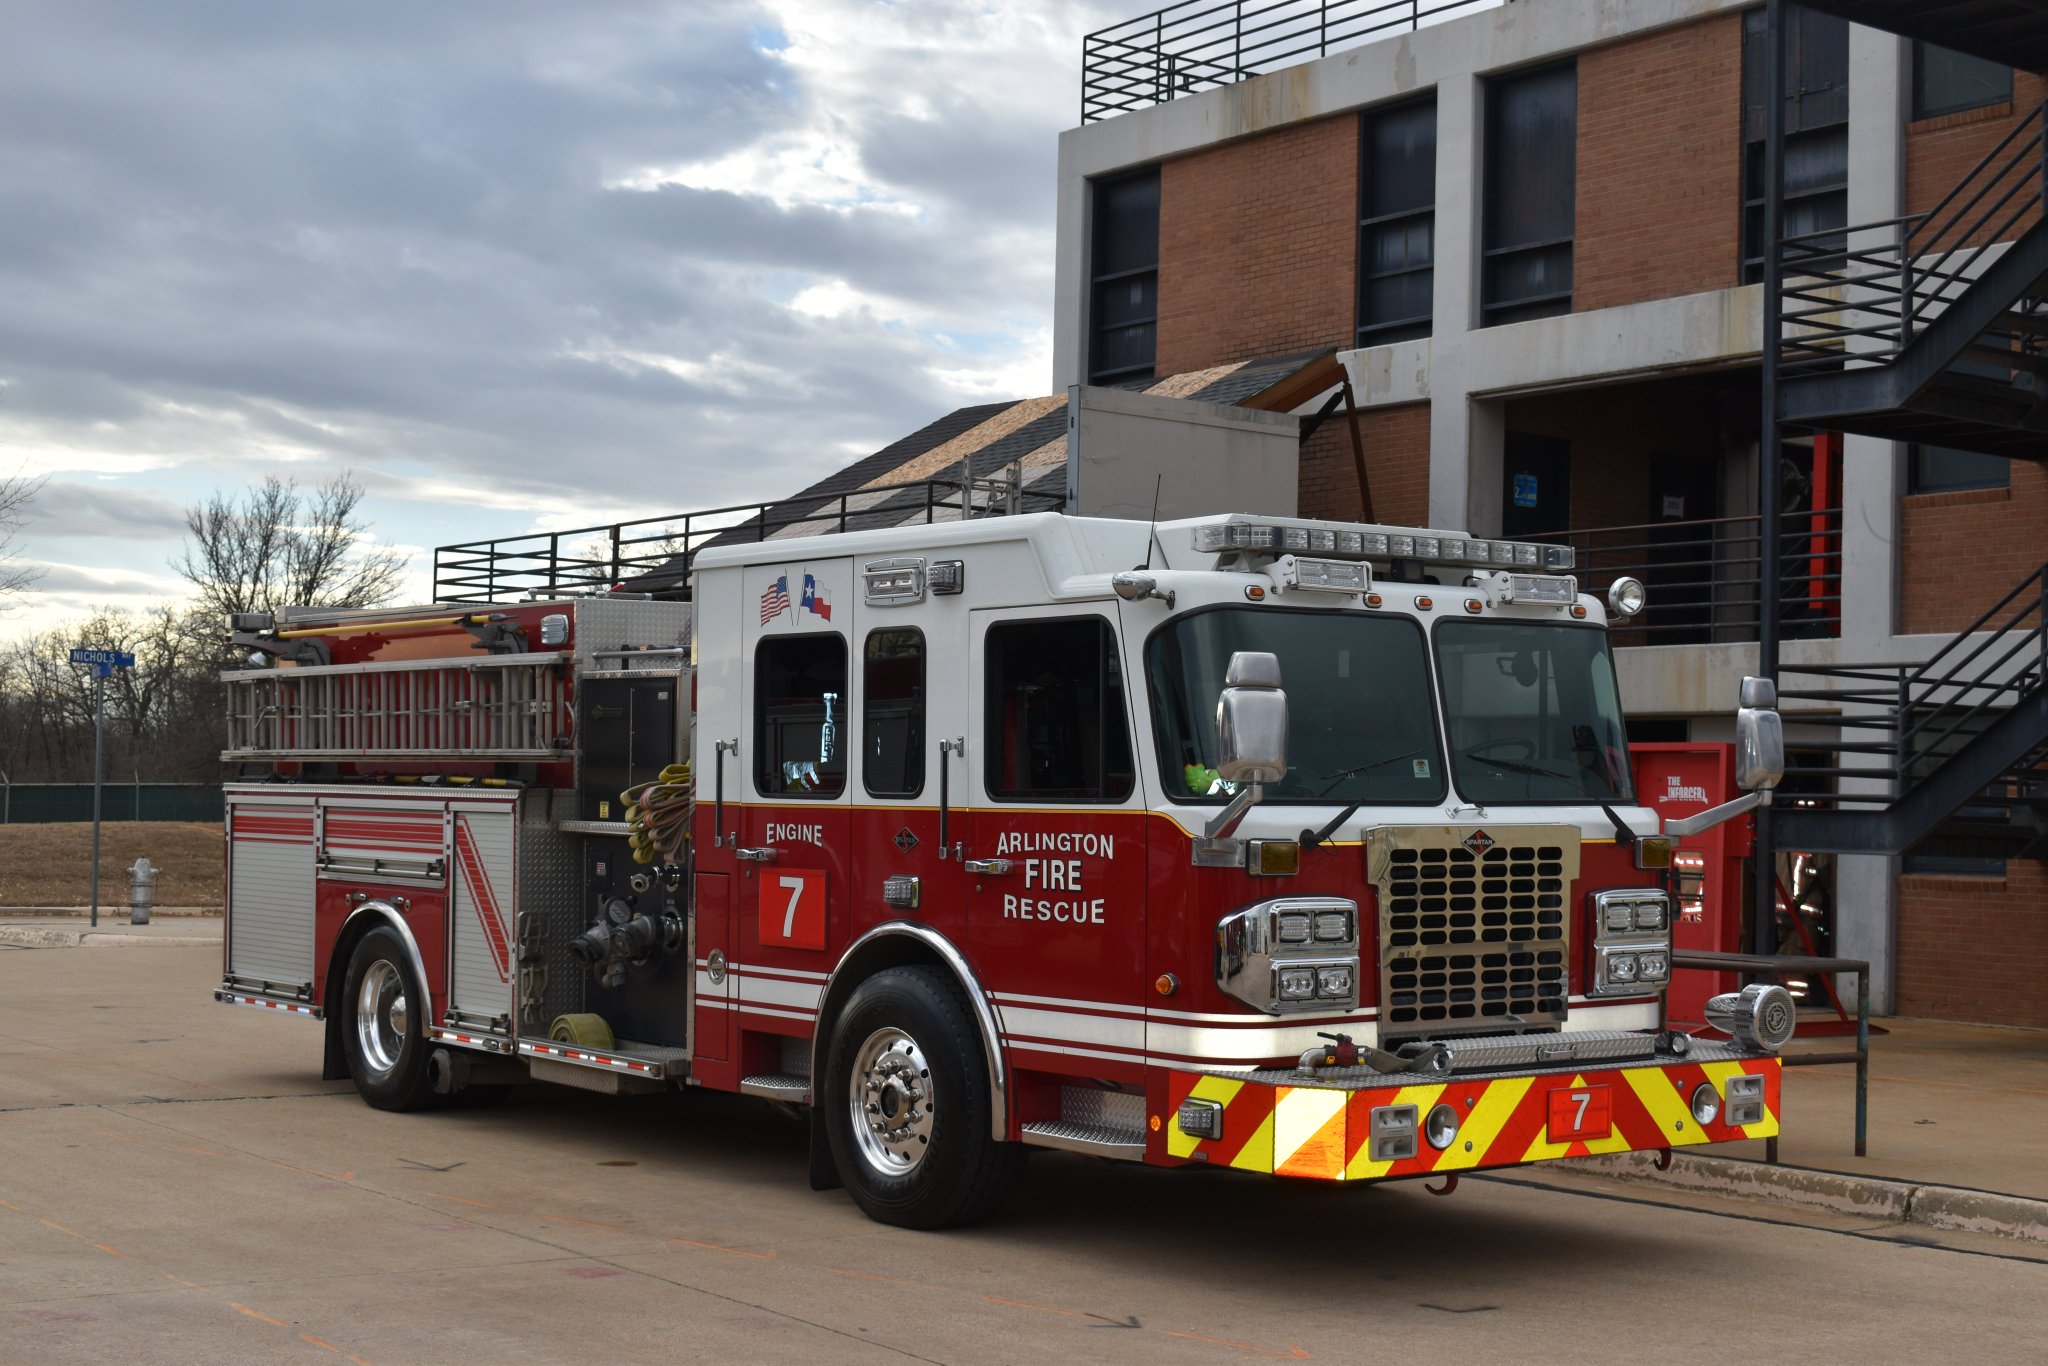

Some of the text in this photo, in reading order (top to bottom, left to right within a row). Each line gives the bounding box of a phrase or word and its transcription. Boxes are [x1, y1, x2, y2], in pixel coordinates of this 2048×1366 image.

[73, 650, 116, 663] NICHOLS
[1667, 775, 1681, 786] THE
[766, 823, 823, 847] ENGINE
[996, 831, 1114, 860] ARLINGTON
[1025, 858, 1082, 892] FIRE
[779, 876, 804, 938] 7
[1003, 893, 1105, 924] RESCUE
[1571, 1093, 1591, 1131] 7
